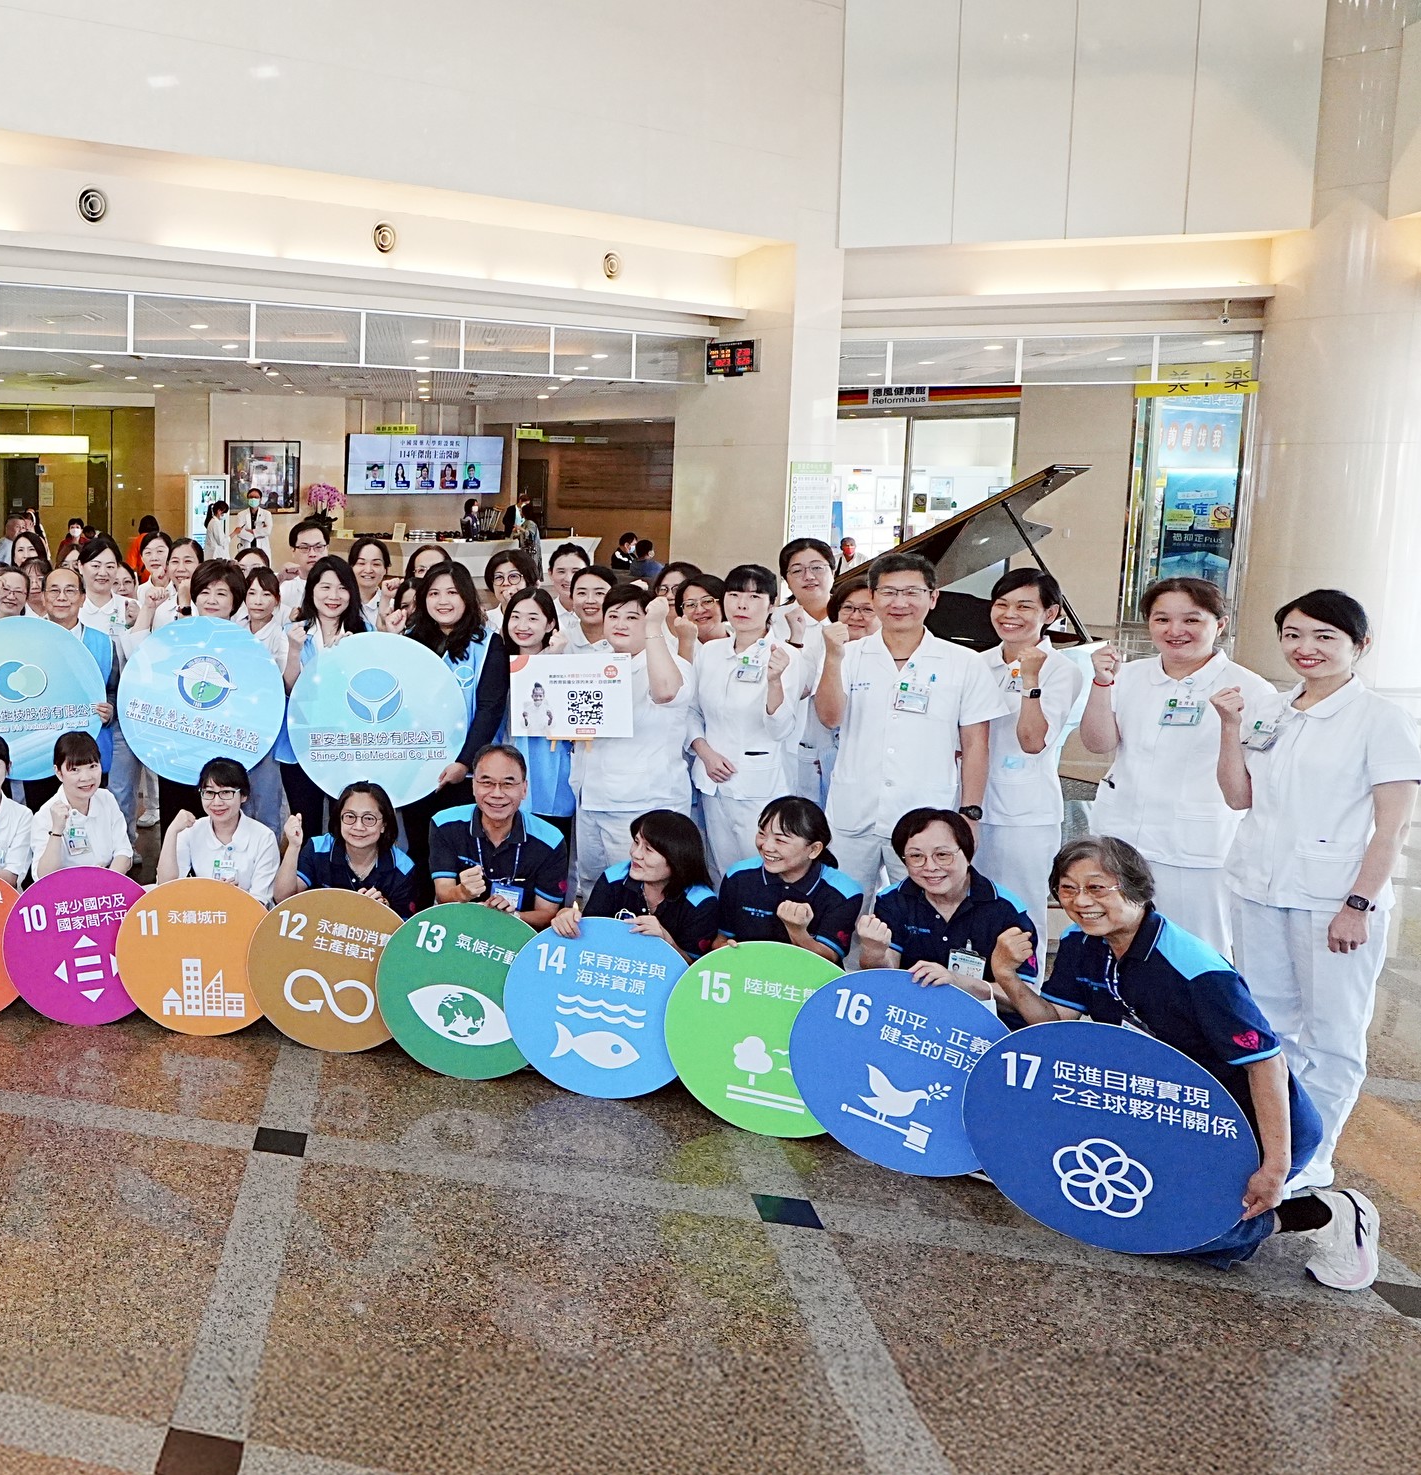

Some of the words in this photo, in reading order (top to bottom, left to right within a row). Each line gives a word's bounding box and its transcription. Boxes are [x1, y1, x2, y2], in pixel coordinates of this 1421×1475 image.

[871, 395, 926, 405] Reformhaus
[872, 386, 926, 397] 德風健康館
[1159, 427, 1222, 448] 詢請找我
[125, 711, 147, 722] CHINA
[148, 717, 178, 732] MEDICAL
[180, 726, 222, 743] UNIVERSITY
[223, 738, 258, 754] HOSPITAL
[129, 699, 259, 746] 中國醫藥大學附設醫院
[310, 731, 445, 746] 聖安生醫股份有限公司
[310, 750, 354, 762] Shine-On
[355, 750, 407, 761] BioMedical
[19, 904, 48, 933] 10
[55, 893, 127, 916] 減少國內及
[167, 910, 227, 925] 永續城市
[57, 909, 128, 933] 國家間不平
[136, 910, 159, 936] 11
[278, 909, 308, 941] 12
[415, 920, 447, 953] 13
[313, 935, 376, 963] 生產模式
[454, 932, 519, 966] 氣候行動
[537, 943, 567, 975] 14
[579, 950, 667, 981] 保育海洋與
[575, 969, 647, 995] 海洋資源
[698, 970, 731, 1003] 15
[835, 988, 872, 1026] 16
[884, 1004, 992, 1054] 和平、正義
[1000, 1051, 1042, 1090] 17
[1053, 1060, 1211, 1109] 促進目標實現
[1052, 1083, 1238, 1140] 之全球夥伴關係
